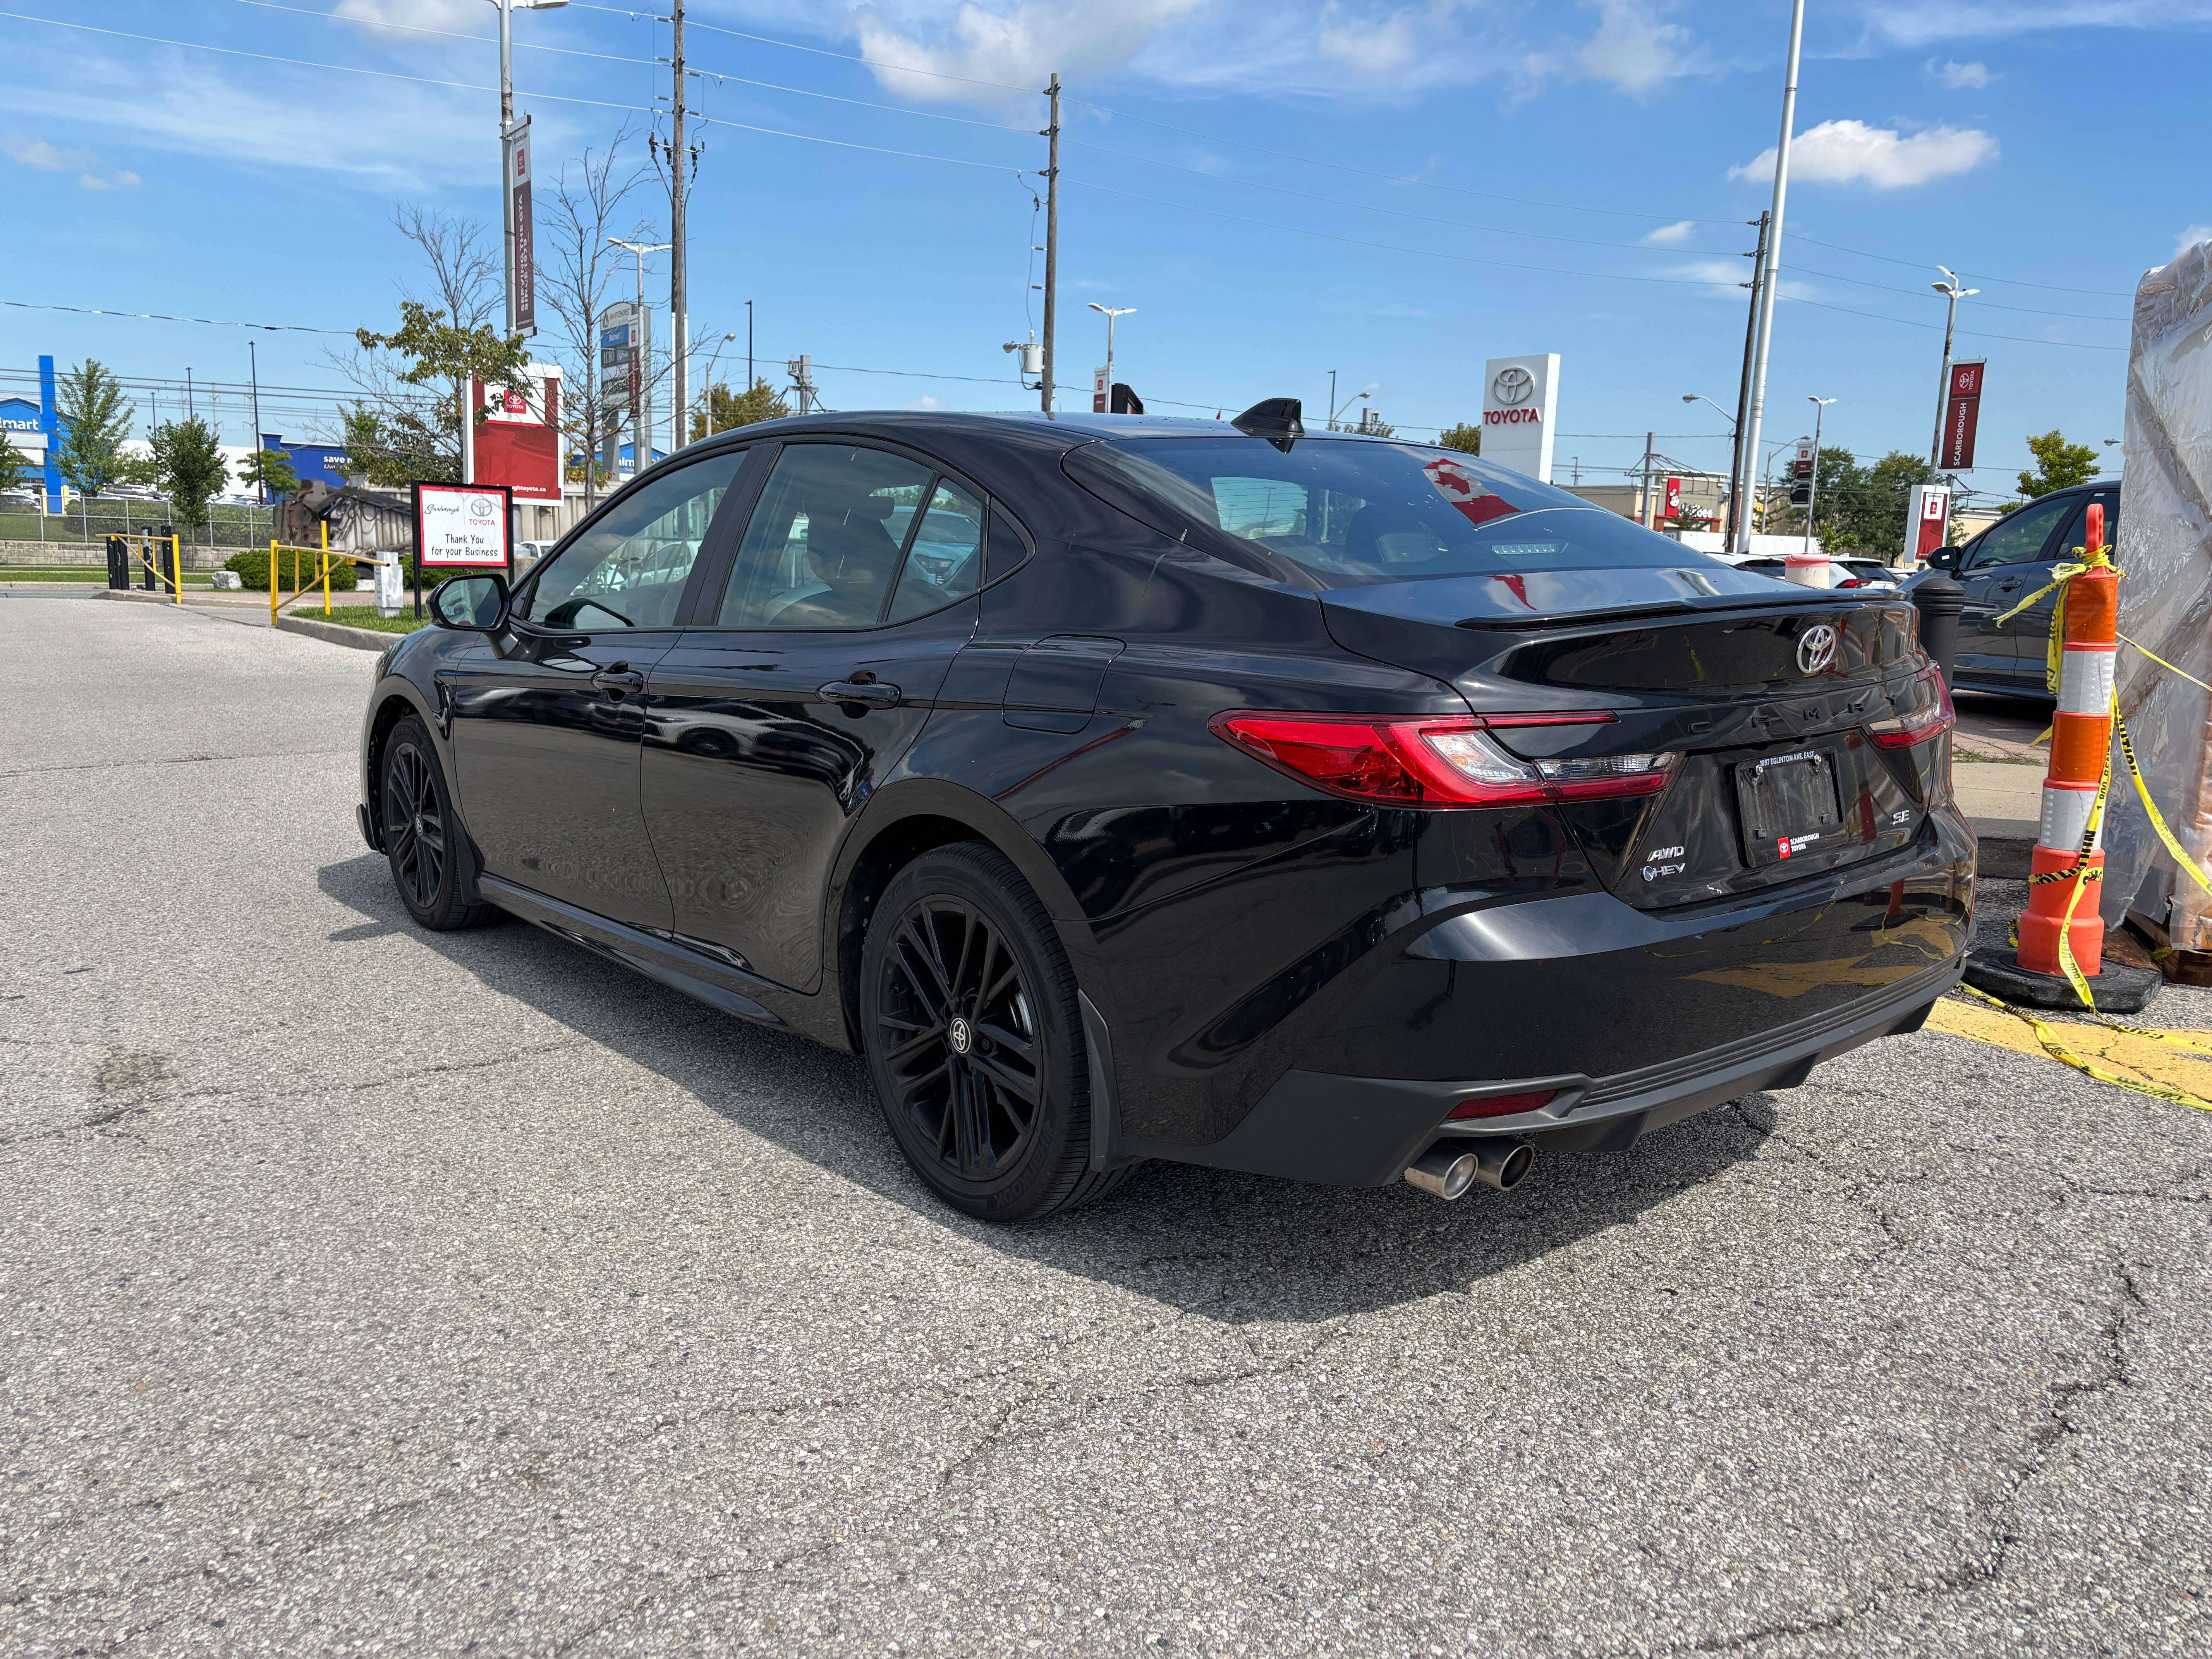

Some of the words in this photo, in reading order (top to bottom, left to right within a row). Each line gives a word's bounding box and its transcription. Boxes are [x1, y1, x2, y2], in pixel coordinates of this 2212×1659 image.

[1483, 408, 1541, 425] TOYOTA
[1953, 402, 1967, 466] SCARBOROUGH
[445, 534, 468, 544] Thank
[471, 534, 484, 544] You
[431, 546, 443, 555] for
[445, 548, 462, 558] your
[465, 547, 498, 556] Business
[1688, 696, 1897, 735] CAMRY
[1759, 758, 1770, 767] 1897
[1770, 754, 1793, 765] EGLINTON
[1793, 752, 1803, 761] AVE.
[1804, 750, 1815, 759] EAST
[1891, 809, 1910, 825] SE
[1790, 833, 1820, 845] SCARBOROUGH
[1647, 846, 1685, 862] AWD
[1791, 843, 1807, 852] TOYOTA
